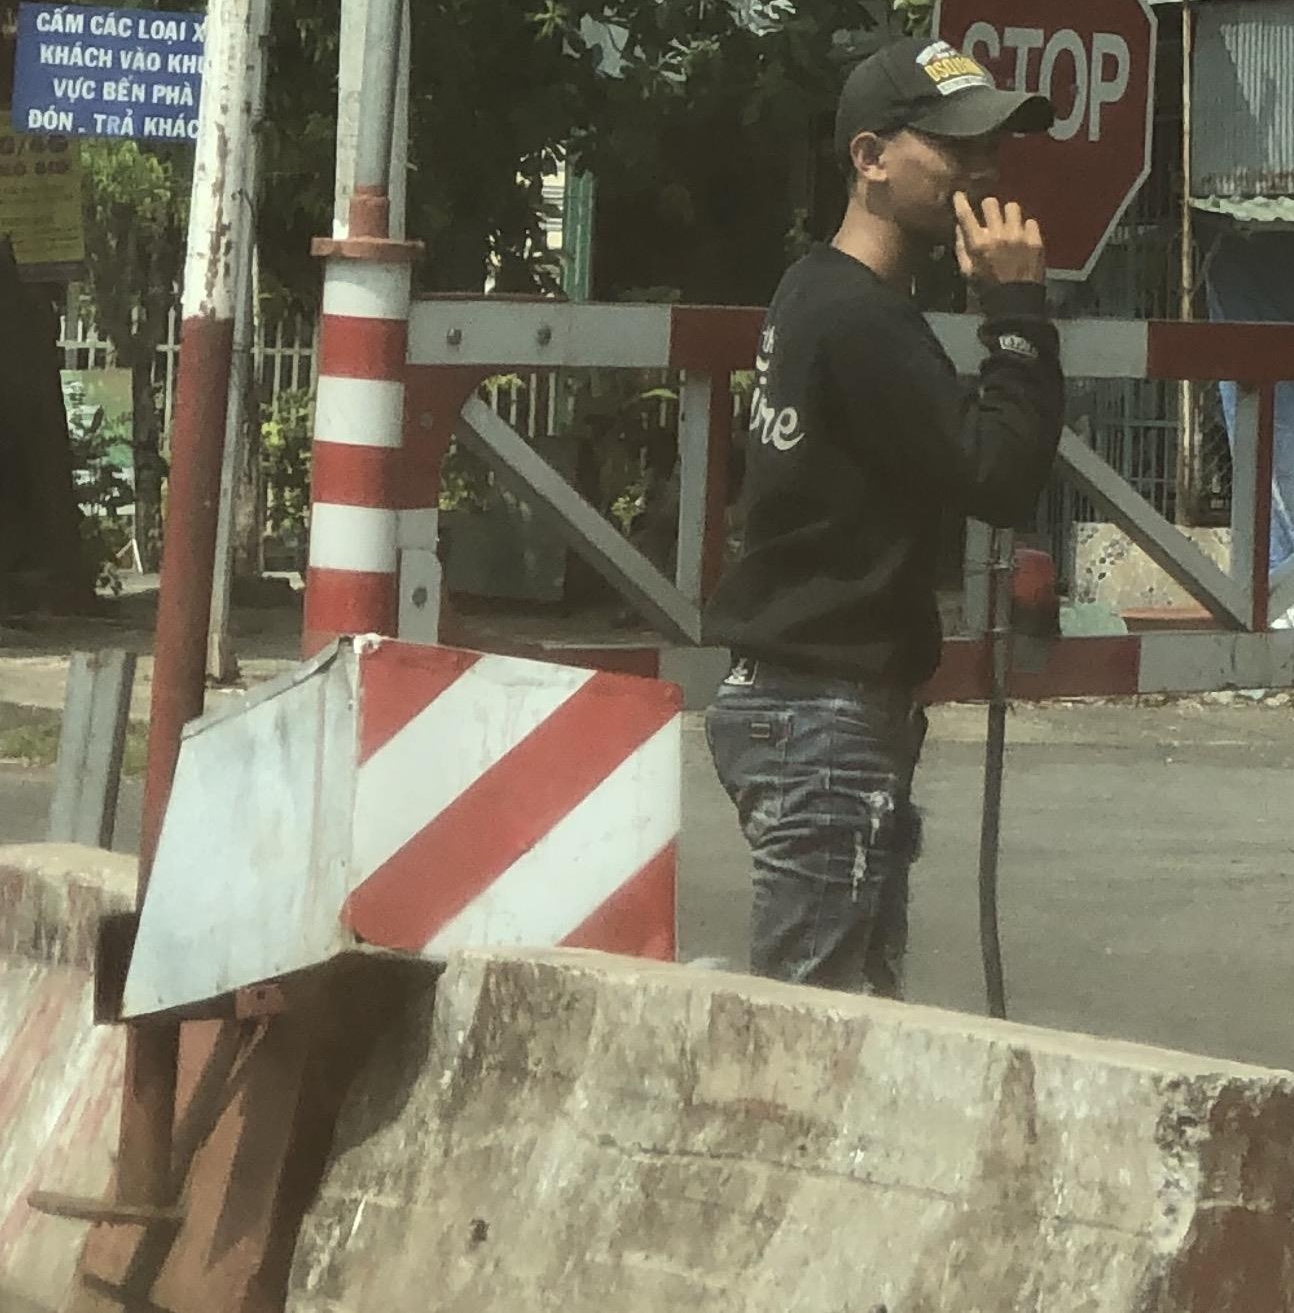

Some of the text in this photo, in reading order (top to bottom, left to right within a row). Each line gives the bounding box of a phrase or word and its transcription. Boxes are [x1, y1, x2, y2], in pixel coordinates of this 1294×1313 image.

[36, 6, 84, 34] CẤM
[90, 12, 133, 38] CÁC
[138, 19, 187, 45] LOẠI
[40, 39, 113, 68] KHÁCH
[119, 46, 161, 72] VÀO
[53, 74, 194, 106] VỰC BẾN PHÀ
[28, 104, 74, 131] ĐÓN
[94, 109, 134, 136] TRẢ
[143, 112, 199, 139] KHÁC
